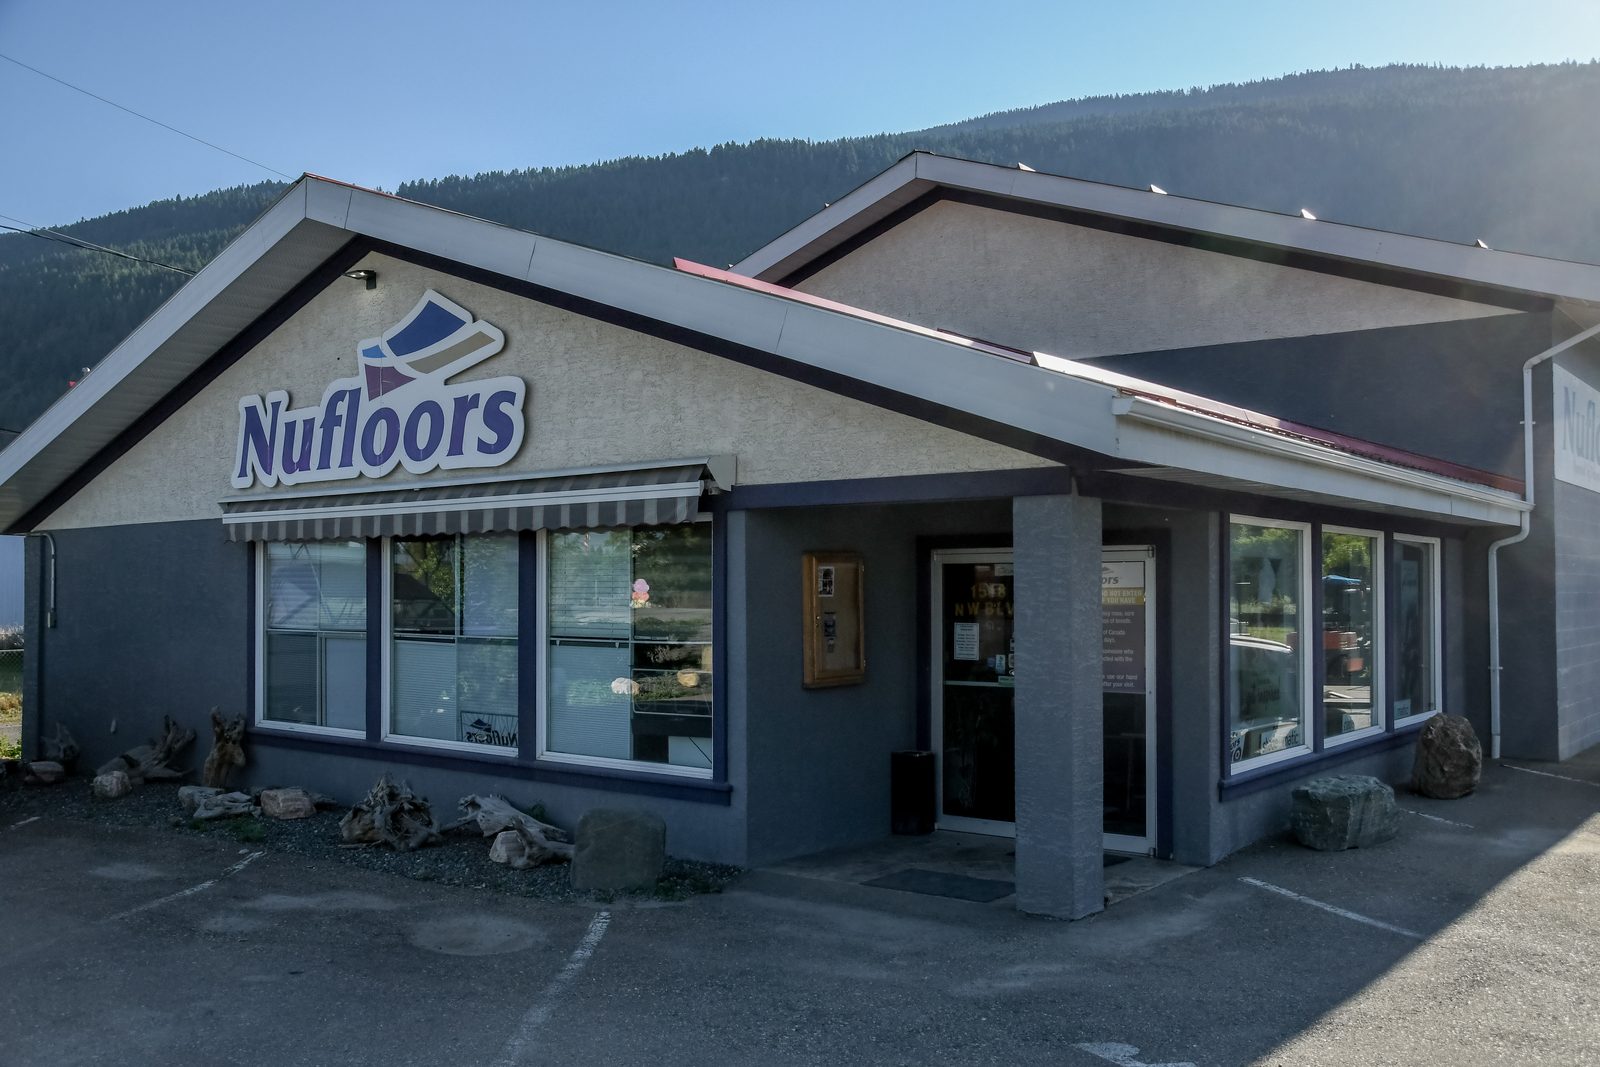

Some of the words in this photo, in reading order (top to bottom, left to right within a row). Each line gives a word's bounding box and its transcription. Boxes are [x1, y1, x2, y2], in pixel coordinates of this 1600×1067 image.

[237, 387, 517, 478] Nufloors
[1562, 386, 1600, 467] Nufl
[985, 602, 1013, 616] BLV
